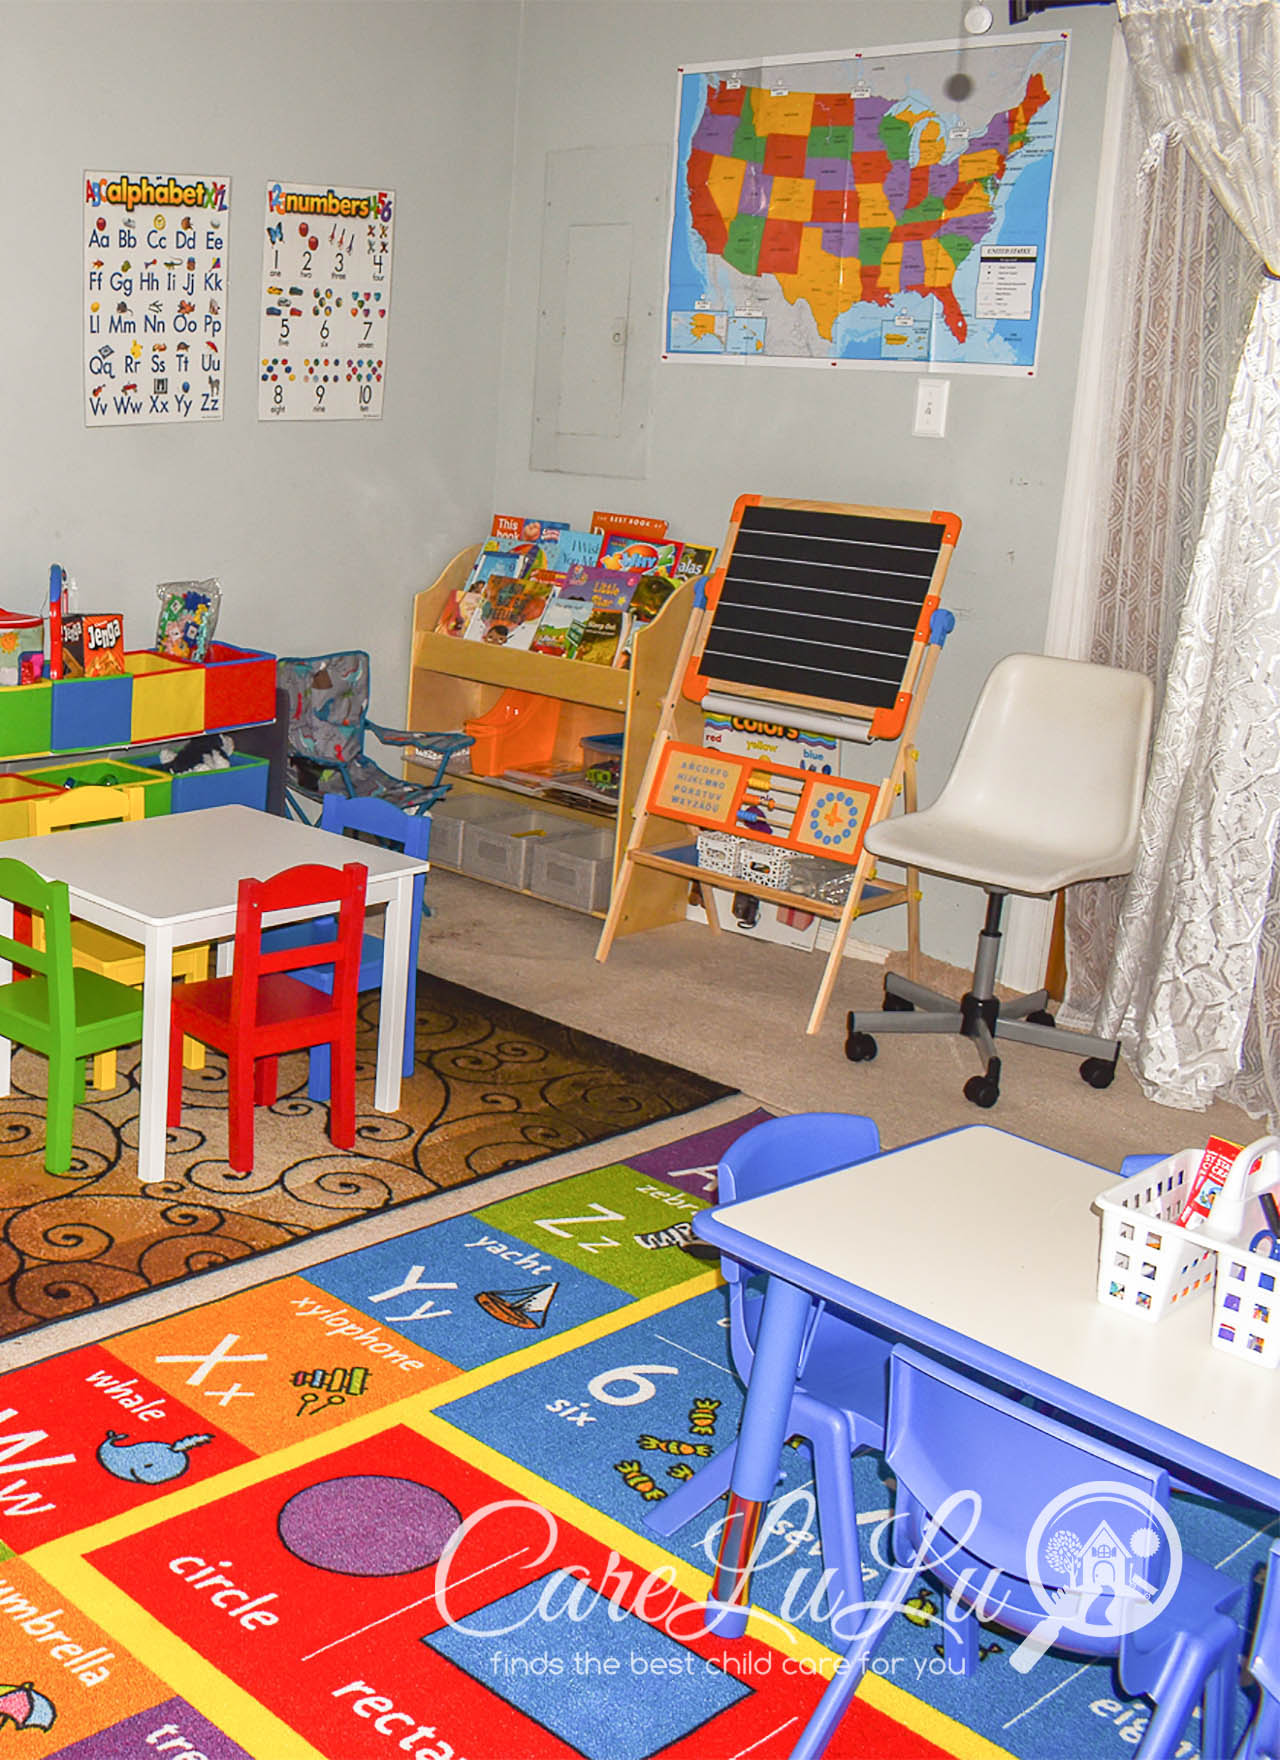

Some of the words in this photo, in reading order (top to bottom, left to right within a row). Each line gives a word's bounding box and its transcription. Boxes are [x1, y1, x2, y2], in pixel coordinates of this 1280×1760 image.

[107, 176, 206, 211] alphabet
[285, 190, 370, 218] numbers
[89, 230, 109, 248] Aa
[119, 230, 136, 248] Bb
[147, 230, 166, 249] Cc
[176, 231, 195, 249] Dd
[206, 232, 222, 249] Ee
[274, 250, 278, 269] 1
[303, 252, 311, 271] 2
[335, 253, 344, 272] 3
[374, 255, 383, 274] 4
[90, 272, 102, 290] Ff
[110, 272, 133, 296] Gg
[140, 273, 159, 291] Hh
[167, 273, 175, 291] Ii
[182, 273, 194, 295] Jj
[205, 273, 222, 291] Kk
[90, 315, 99, 333] Ll
[109, 315, 135, 333] Mm
[144, 315, 165, 333] Nn
[173, 315, 197, 333] Oo
[205, 315, 221, 337] Pp
[280, 319, 289, 337] 5
[320, 320, 329, 339] 6
[363, 322, 372, 340] 7
[90, 356, 115, 379] Qq
[125, 356, 140, 373] Rr
[151, 355, 165, 372] Ss
[176, 354, 188, 372] Tt
[202, 354, 220, 371] Uu
[90, 397, 107, 415] Vv
[114, 396, 142, 415] Ww
[149, 395, 169, 413] Xx
[175, 394, 192, 417] Yy
[201, 393, 218, 411] Zz
[274, 385, 283, 404] 8
[316, 385, 325, 404] 9
[359, 385, 371, 404] 10
[499, 518, 518, 529] This
[629, 517, 651, 527] BOOK
[88, 619, 121, 649] Jenga
[706, 734, 722, 743] red
[746, 739, 777, 753] yellow
[803, 749, 823, 760] blue
[635, 1181, 699, 1216] zebr
[464, 1233, 552, 1278] yacht
[290, 1294, 425, 1374] xylophone
[85, 1368, 168, 1424] whale
[588, 1364, 679, 1406] 6
[545, 1395, 594, 1428] six
[169, 1552, 279, 1631] circle
[332, 1680, 466, 1760] recta
